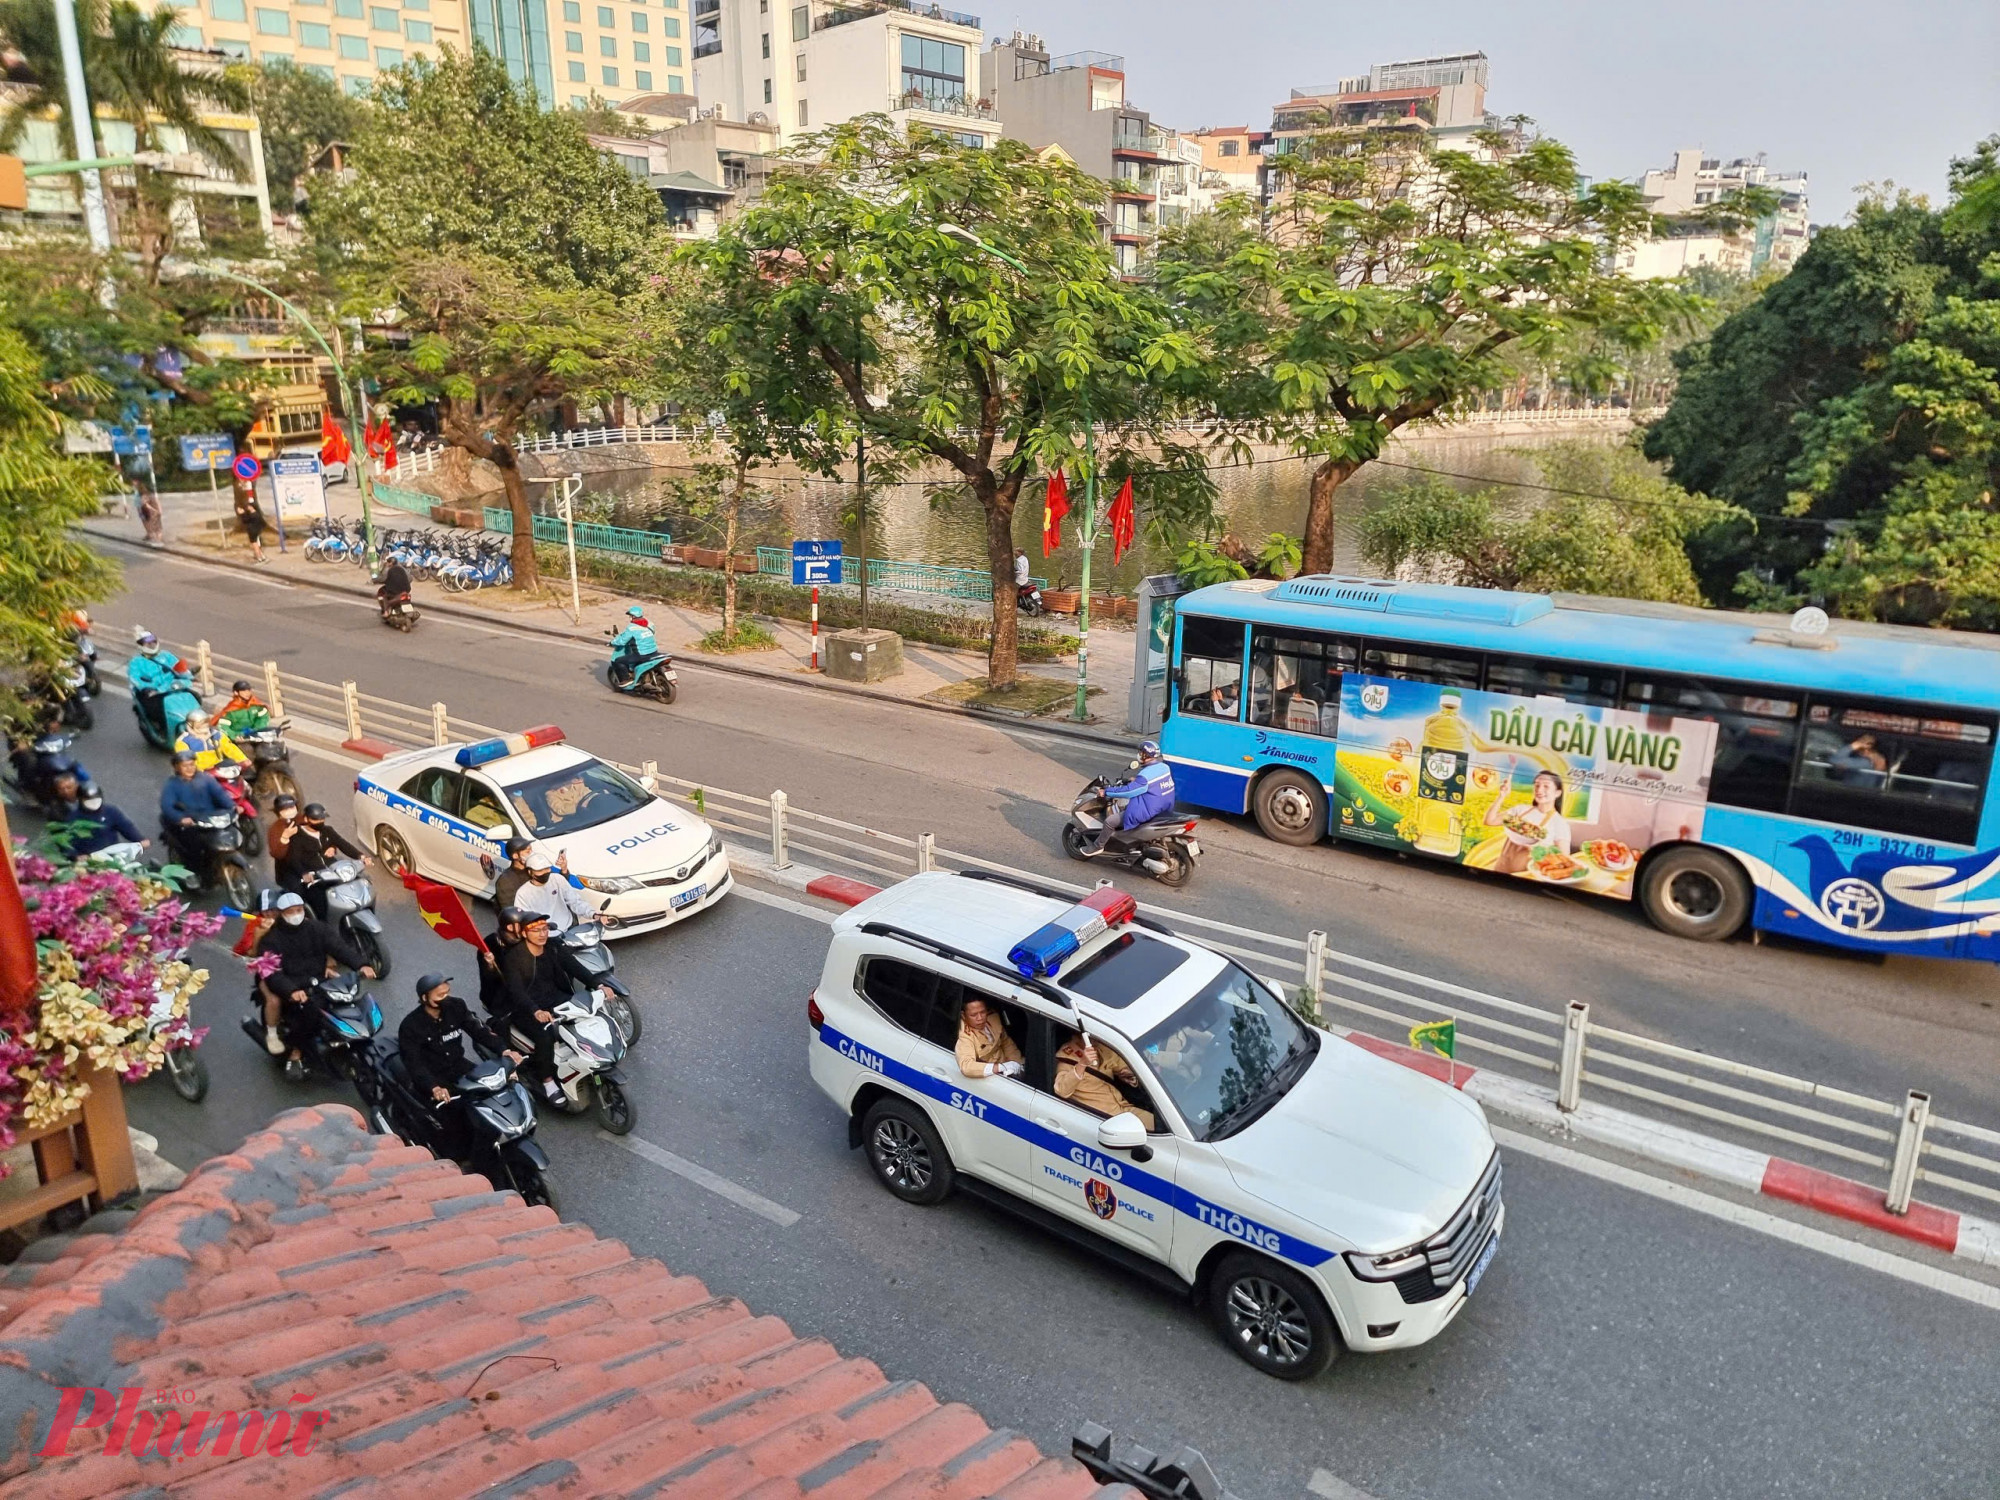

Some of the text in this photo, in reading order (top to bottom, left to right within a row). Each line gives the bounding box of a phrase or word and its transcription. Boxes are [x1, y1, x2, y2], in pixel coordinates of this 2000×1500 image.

[1363, 693, 1382, 708] Oily
[1490, 705, 1682, 772] DẦU CẢI VÀNG
[1258, 746, 1318, 764] HANOIBUS
[1393, 781, 1402, 793] 6
[405, 805, 423, 820] SÁT
[428, 815, 450, 833] GIAO
[606, 823, 681, 855] POLICE
[1832, 830, 1864, 847] 29H
[1880, 837, 1936, 860] 937.68
[838, 1039, 1280, 1252] CẢNH SÁT GIAO THÔNG
[1043, 1165, 1155, 1222] TRAFFIC POLICE
